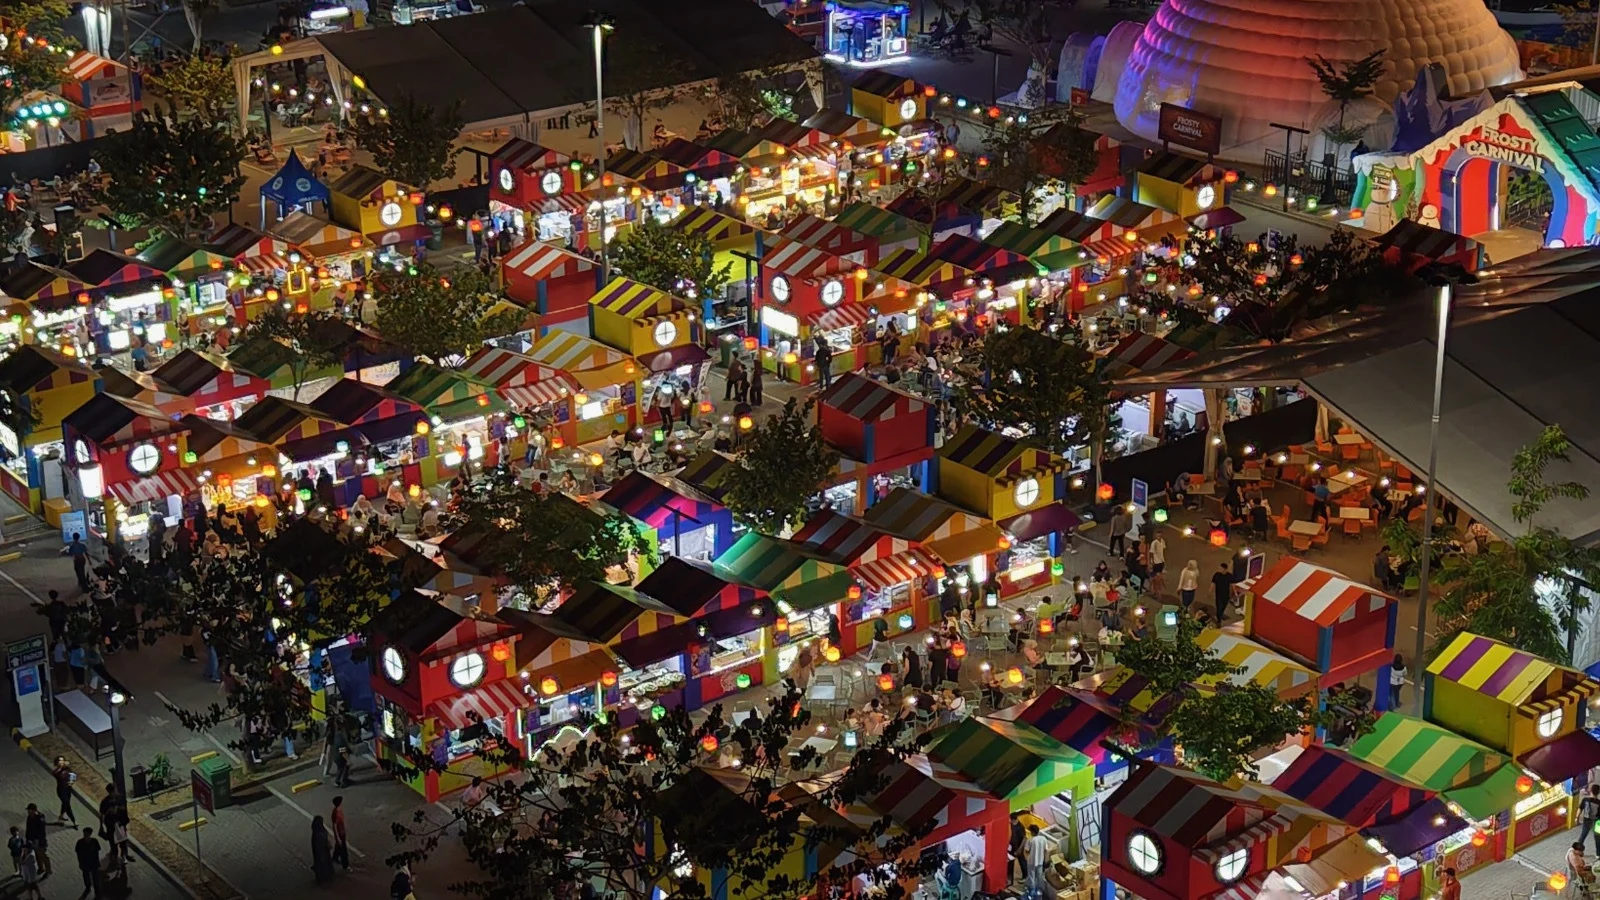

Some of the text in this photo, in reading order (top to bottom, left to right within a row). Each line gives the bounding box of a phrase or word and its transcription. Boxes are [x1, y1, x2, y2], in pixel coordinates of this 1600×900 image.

[1173, 122, 1203, 138] CARNIVAL
[1177, 116, 1200, 128] FROSTY
[1481, 126, 1539, 153] FROSTY
[1466, 140, 1545, 174] CARNIVAL
